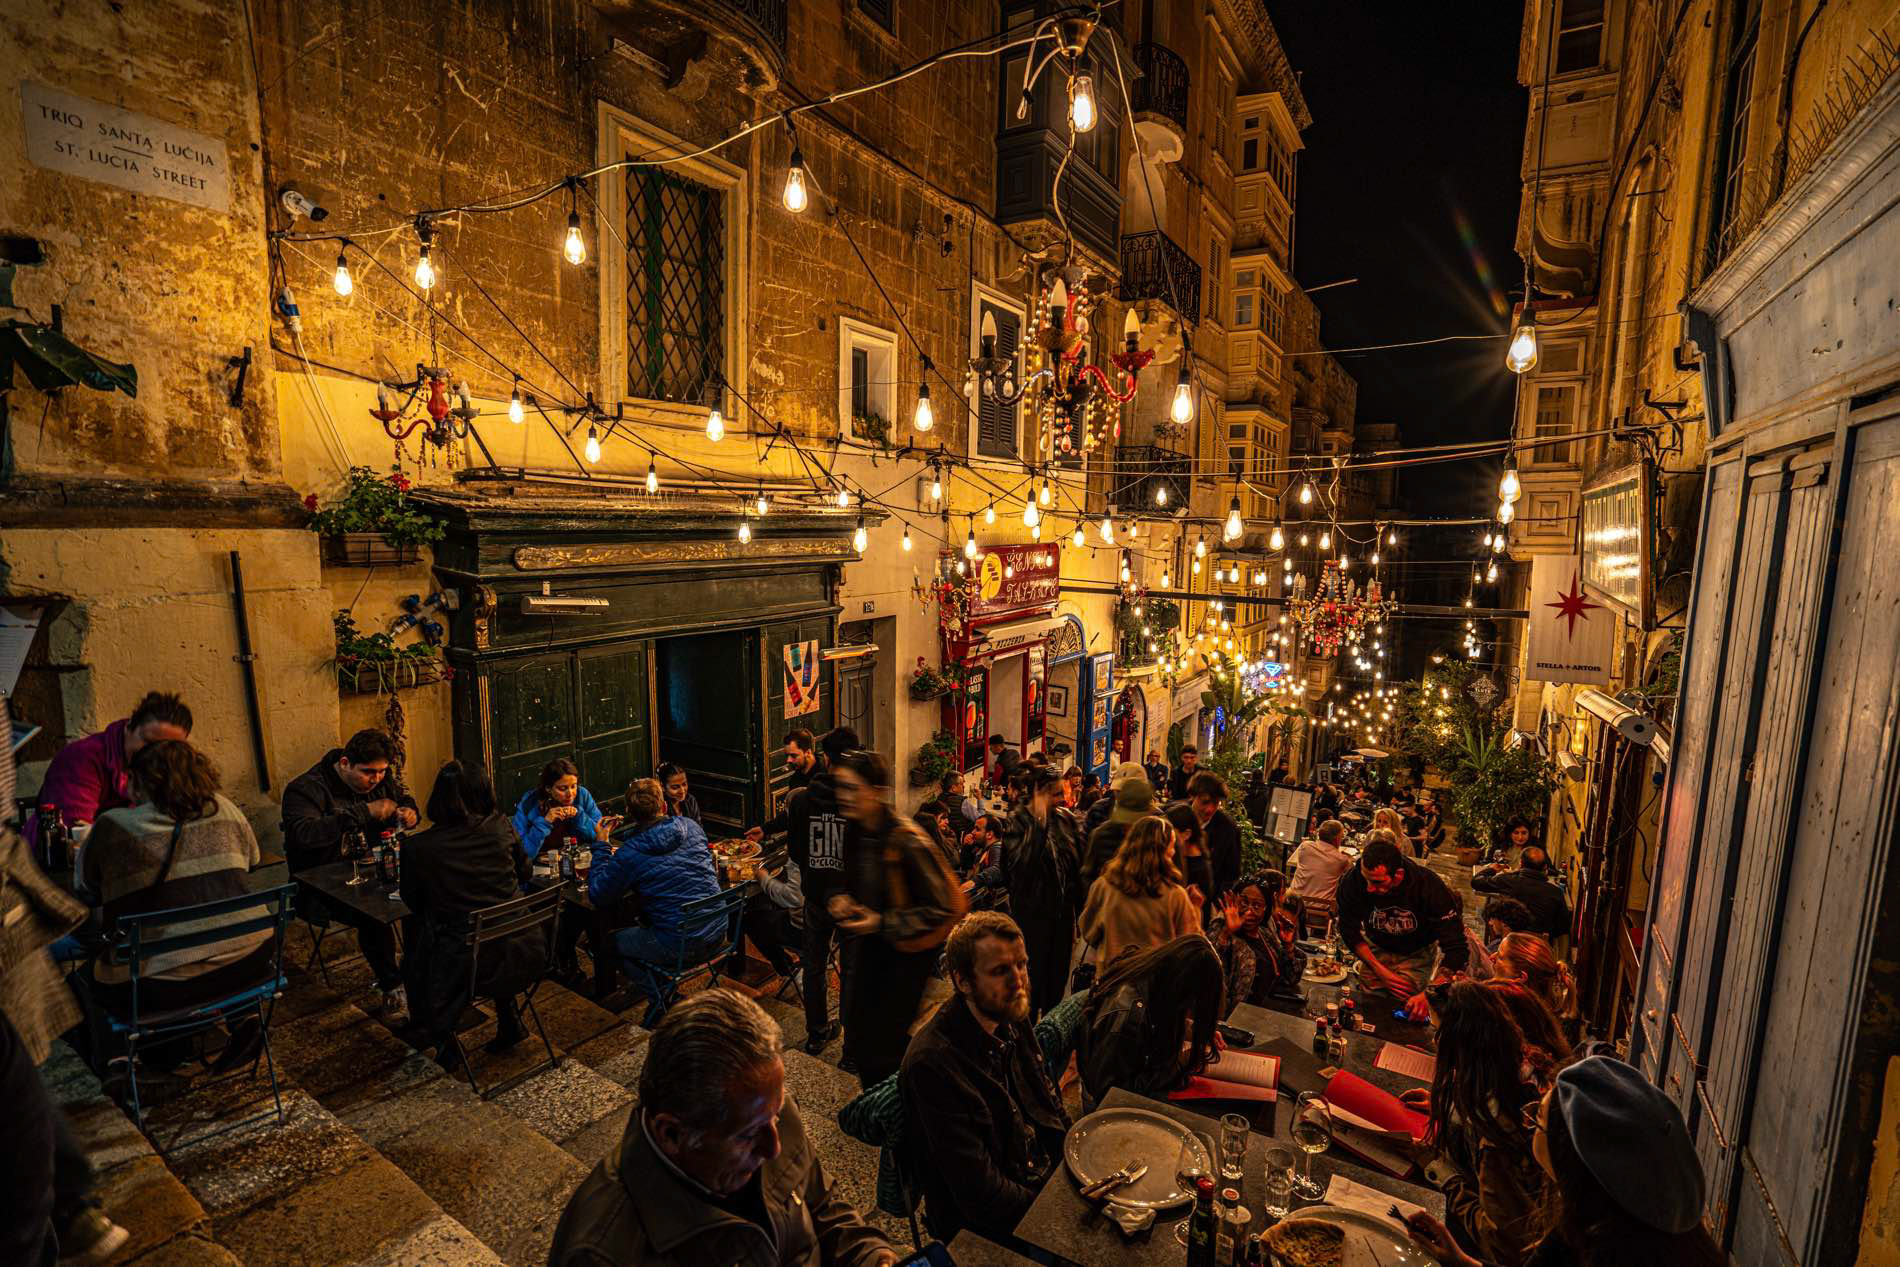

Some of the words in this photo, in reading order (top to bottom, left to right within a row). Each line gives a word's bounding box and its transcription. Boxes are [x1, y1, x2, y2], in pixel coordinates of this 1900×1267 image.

[39, 105, 83, 129] TRIQ
[99, 122, 153, 149] SANTA
[55, 140, 79, 158] ST.
[89, 150, 139, 173] LUCIA
[152, 166, 207, 190] STREET
[822, 813, 835, 822] IT'S
[809, 821, 845, 859] GIN
